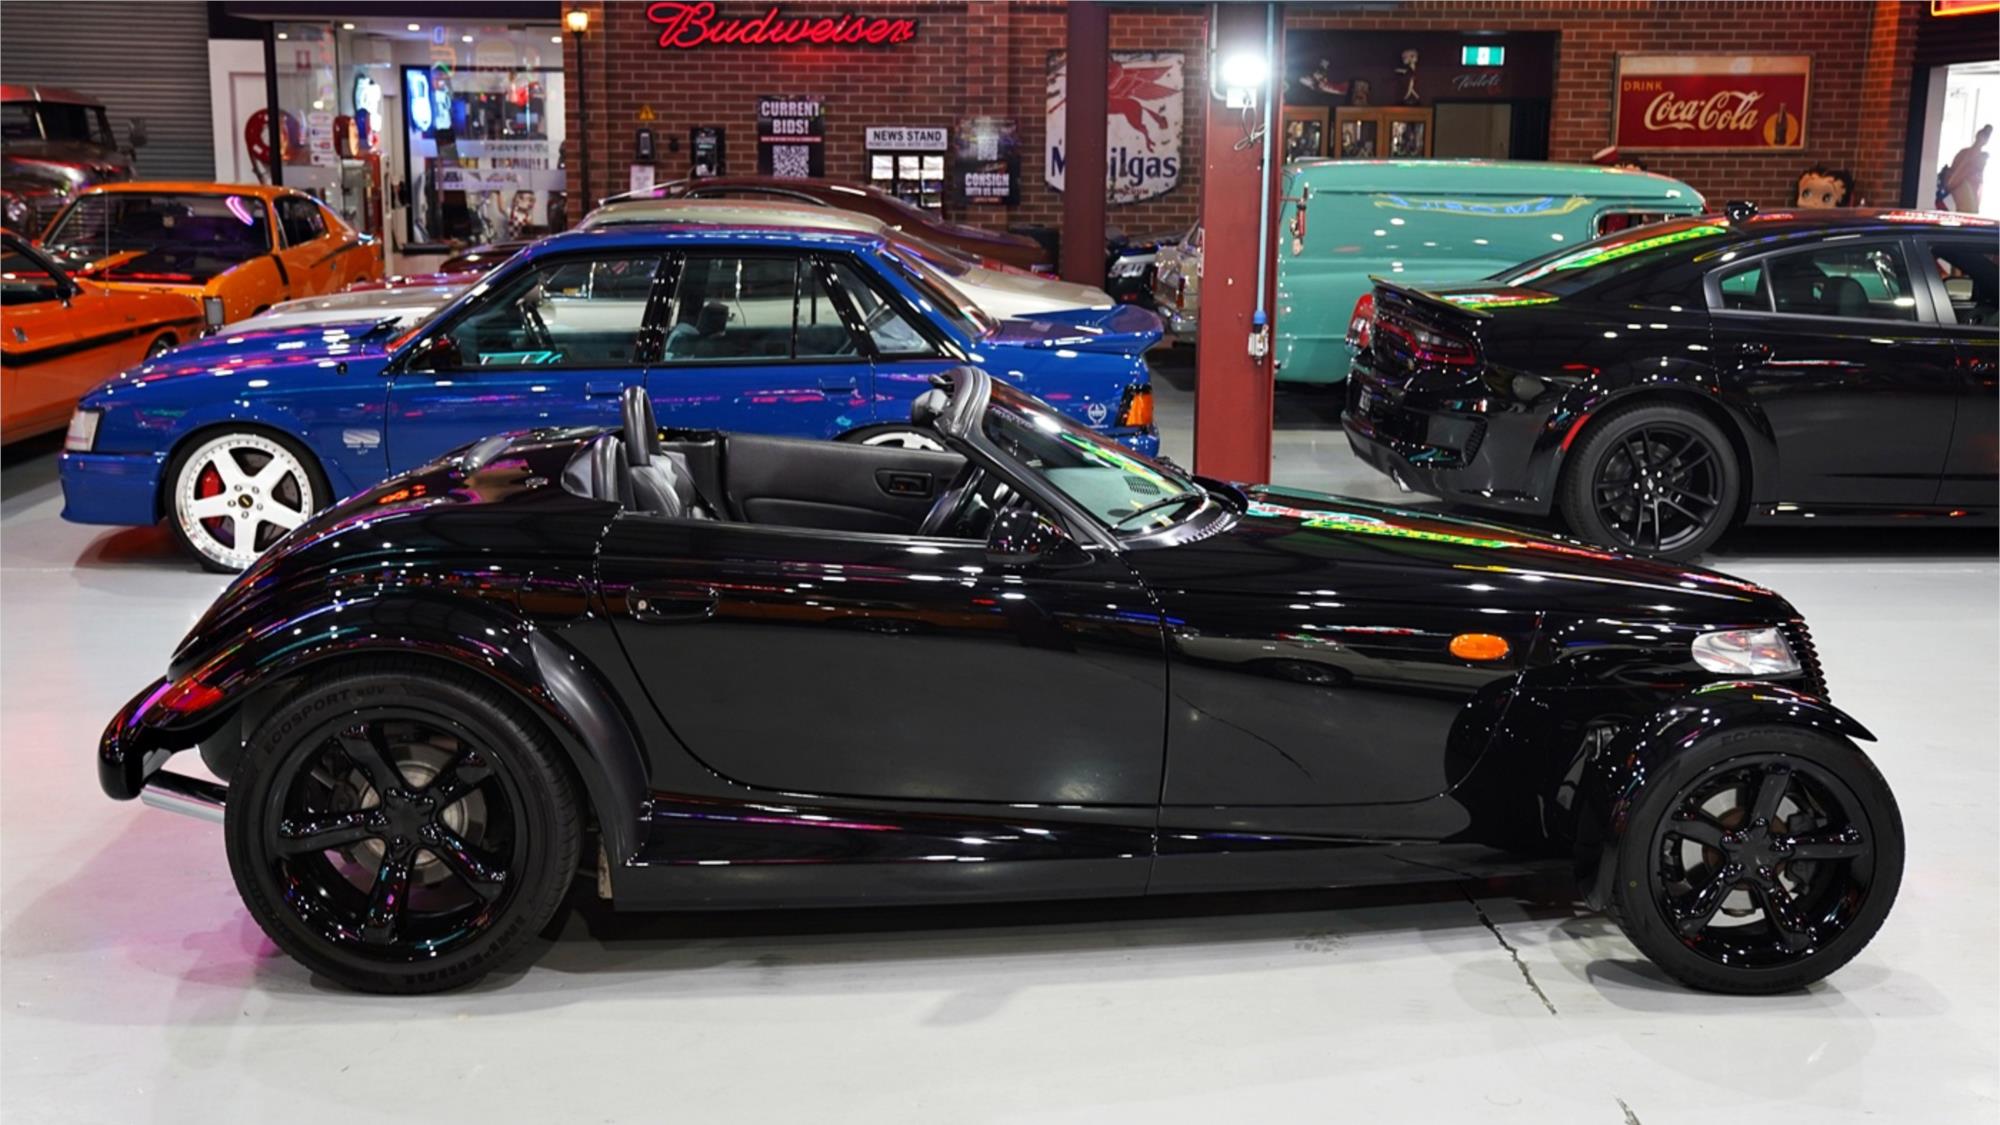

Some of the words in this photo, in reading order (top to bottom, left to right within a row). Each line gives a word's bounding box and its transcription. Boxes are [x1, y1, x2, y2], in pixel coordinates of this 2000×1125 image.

[646, 2, 916, 48] Budweiser
[1623, 80, 1663, 92] DRINK
[761, 101, 820, 117] CURRENT
[1644, 90, 1764, 131] Coca-Cola
[772, 119, 809, 135] BIDS!
[873, 130, 904, 142] NEWS
[906, 130, 942, 142] STAND
[1051, 146, 1177, 188] Milgas
[965, 172, 1010, 187] CONSIGN
[263, 688, 351, 755] ECOSPORT
